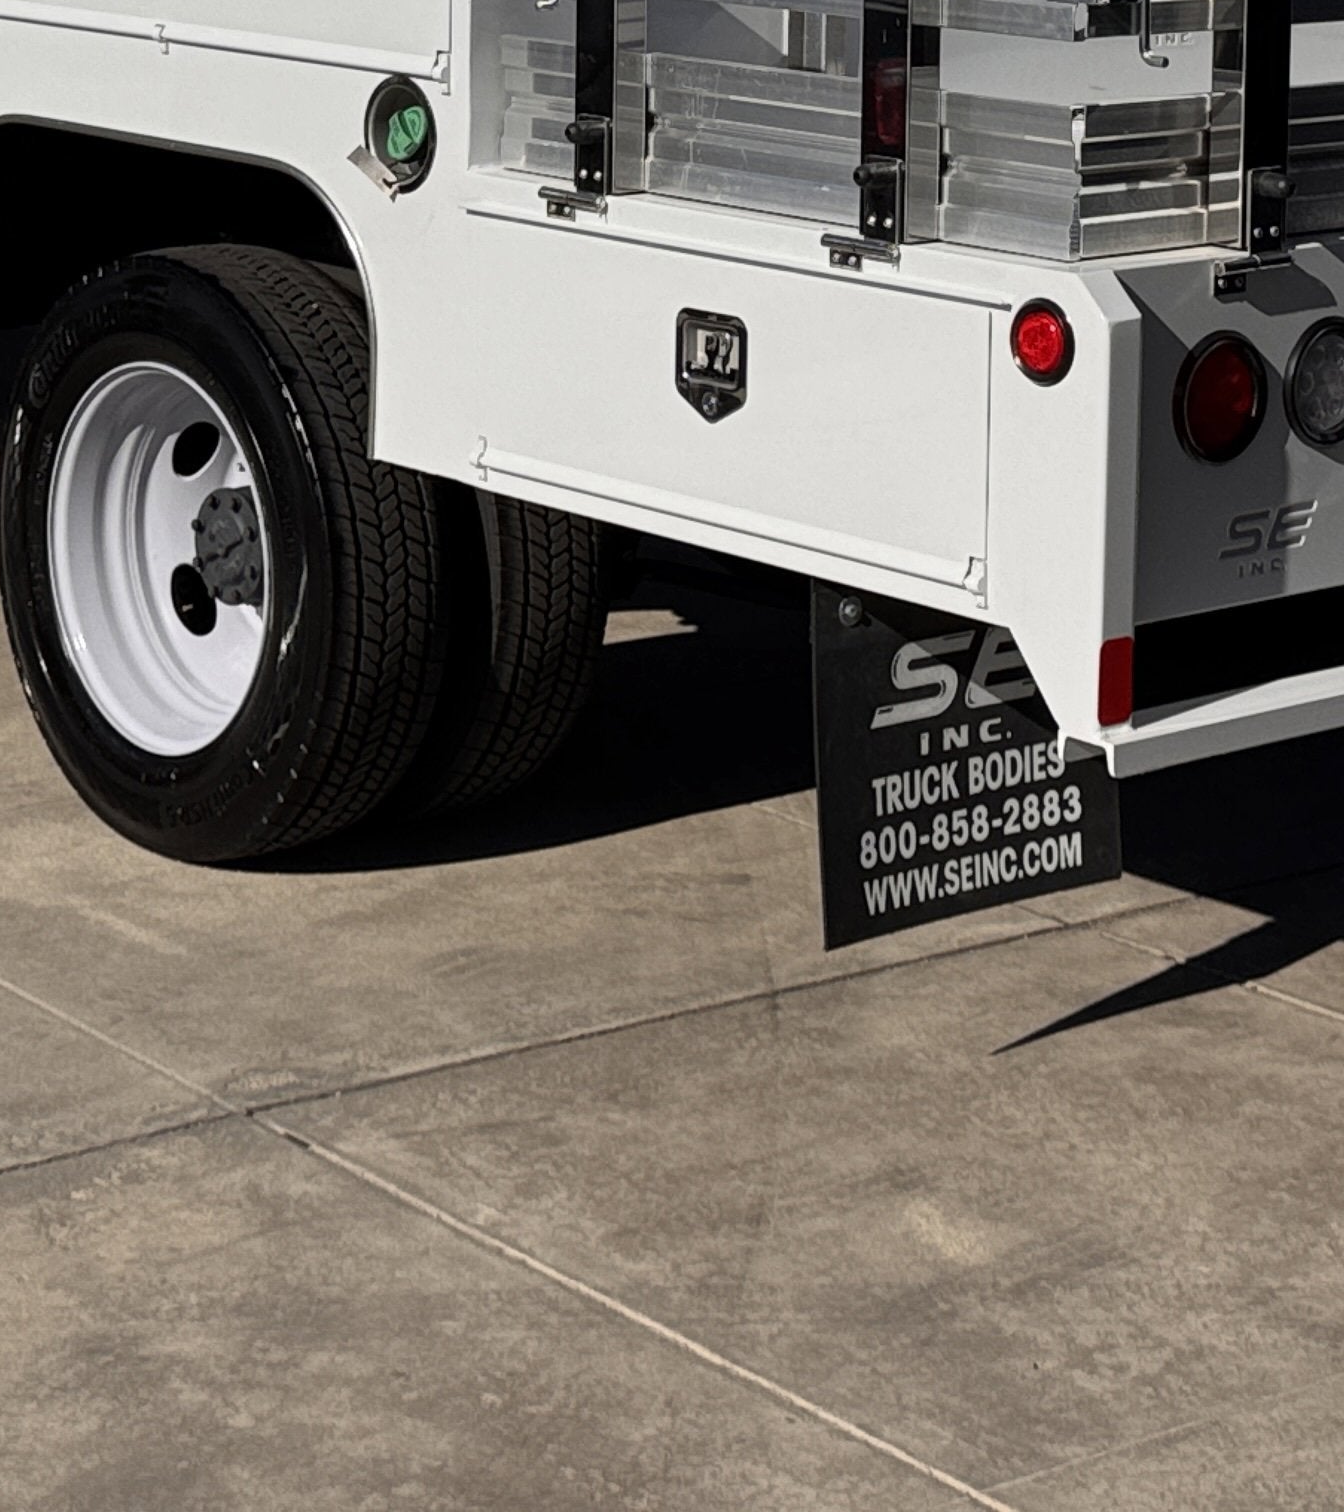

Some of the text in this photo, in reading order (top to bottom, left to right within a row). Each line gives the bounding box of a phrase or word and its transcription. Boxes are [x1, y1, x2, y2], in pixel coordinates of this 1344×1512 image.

[871, 739, 1066, 817] TRUCK BODIES
[859, 785, 1083, 870] 800-858-2883
[863, 831, 1084, 917] WWW.SEINC.COM
